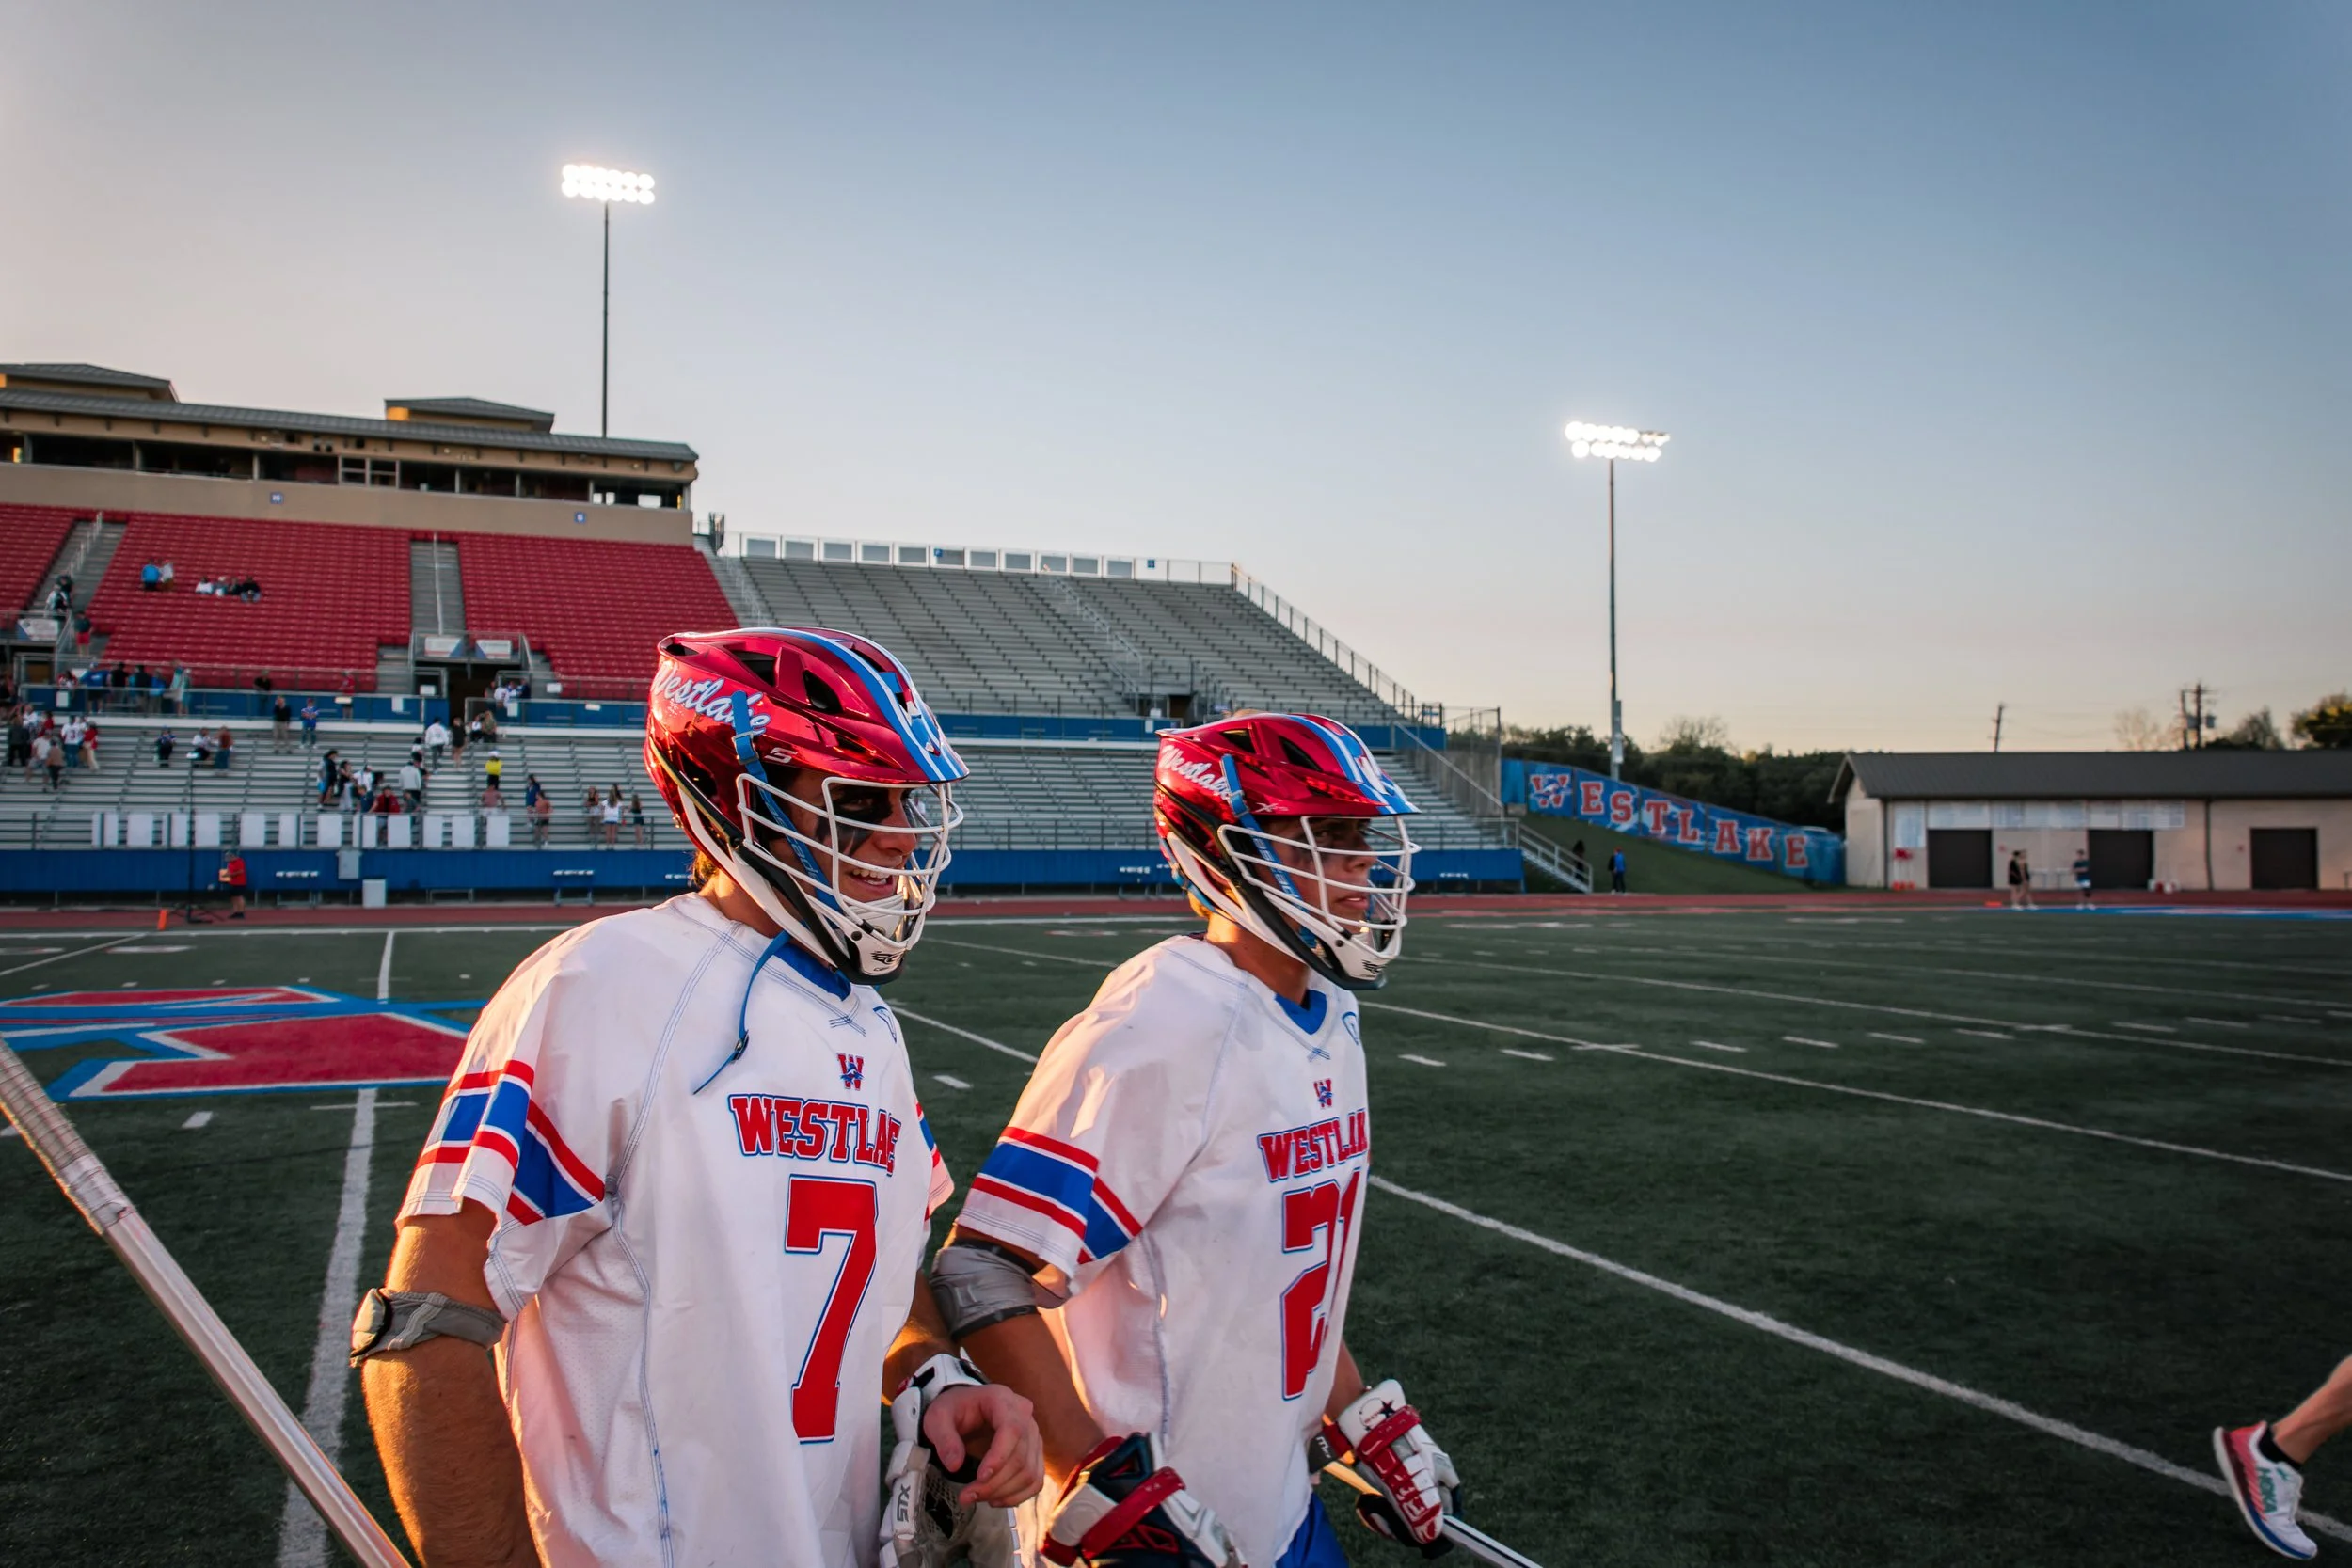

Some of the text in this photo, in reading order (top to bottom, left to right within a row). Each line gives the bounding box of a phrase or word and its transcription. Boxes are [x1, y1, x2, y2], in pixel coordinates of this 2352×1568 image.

[1530, 773, 1808, 869] WESTLAKE
[728, 1093, 902, 1177] WESTLAE
[785, 1173, 880, 1445] 7
[897, 1483, 911, 1523] STX
[2256, 1467, 2278, 1513] HOKA
